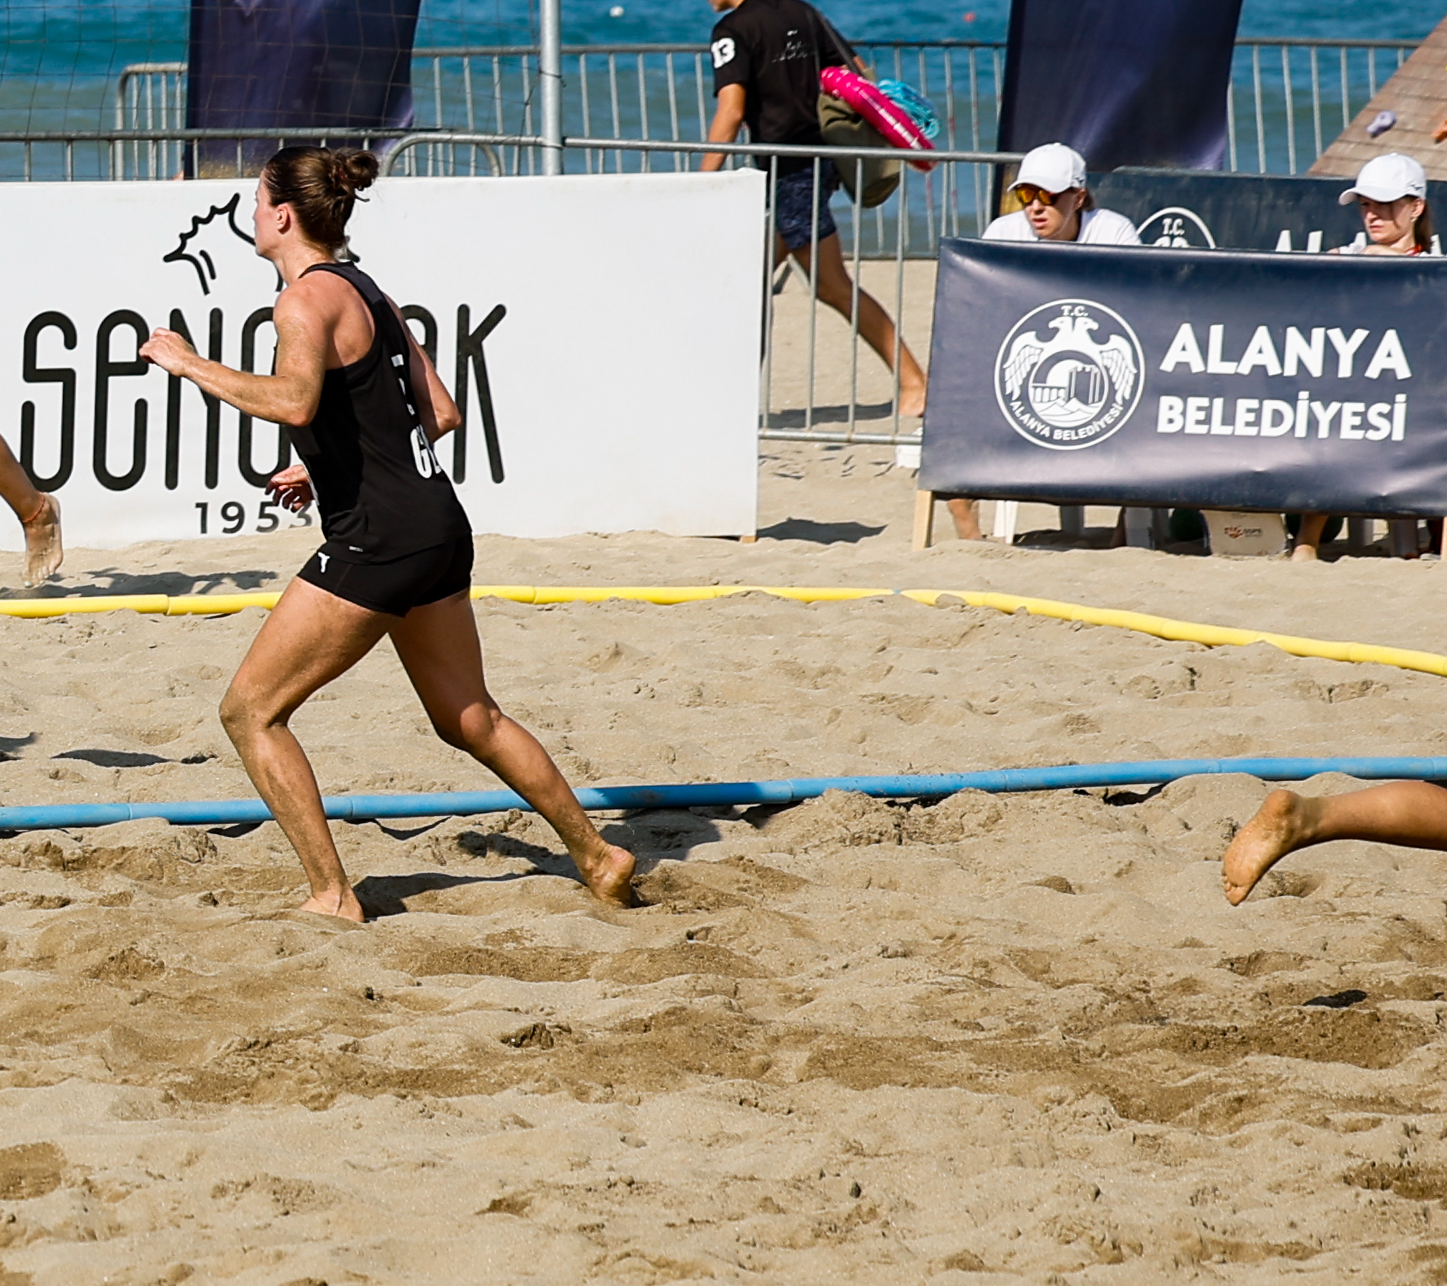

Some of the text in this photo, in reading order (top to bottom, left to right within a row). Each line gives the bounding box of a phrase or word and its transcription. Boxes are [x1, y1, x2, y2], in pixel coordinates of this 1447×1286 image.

[711, 37, 735, 69] 13
[1159, 323, 1412, 380] ALANYA
[1010, 400, 1051, 439] ALANYA
[1157, 391, 1407, 441] BELEDİYESİ
